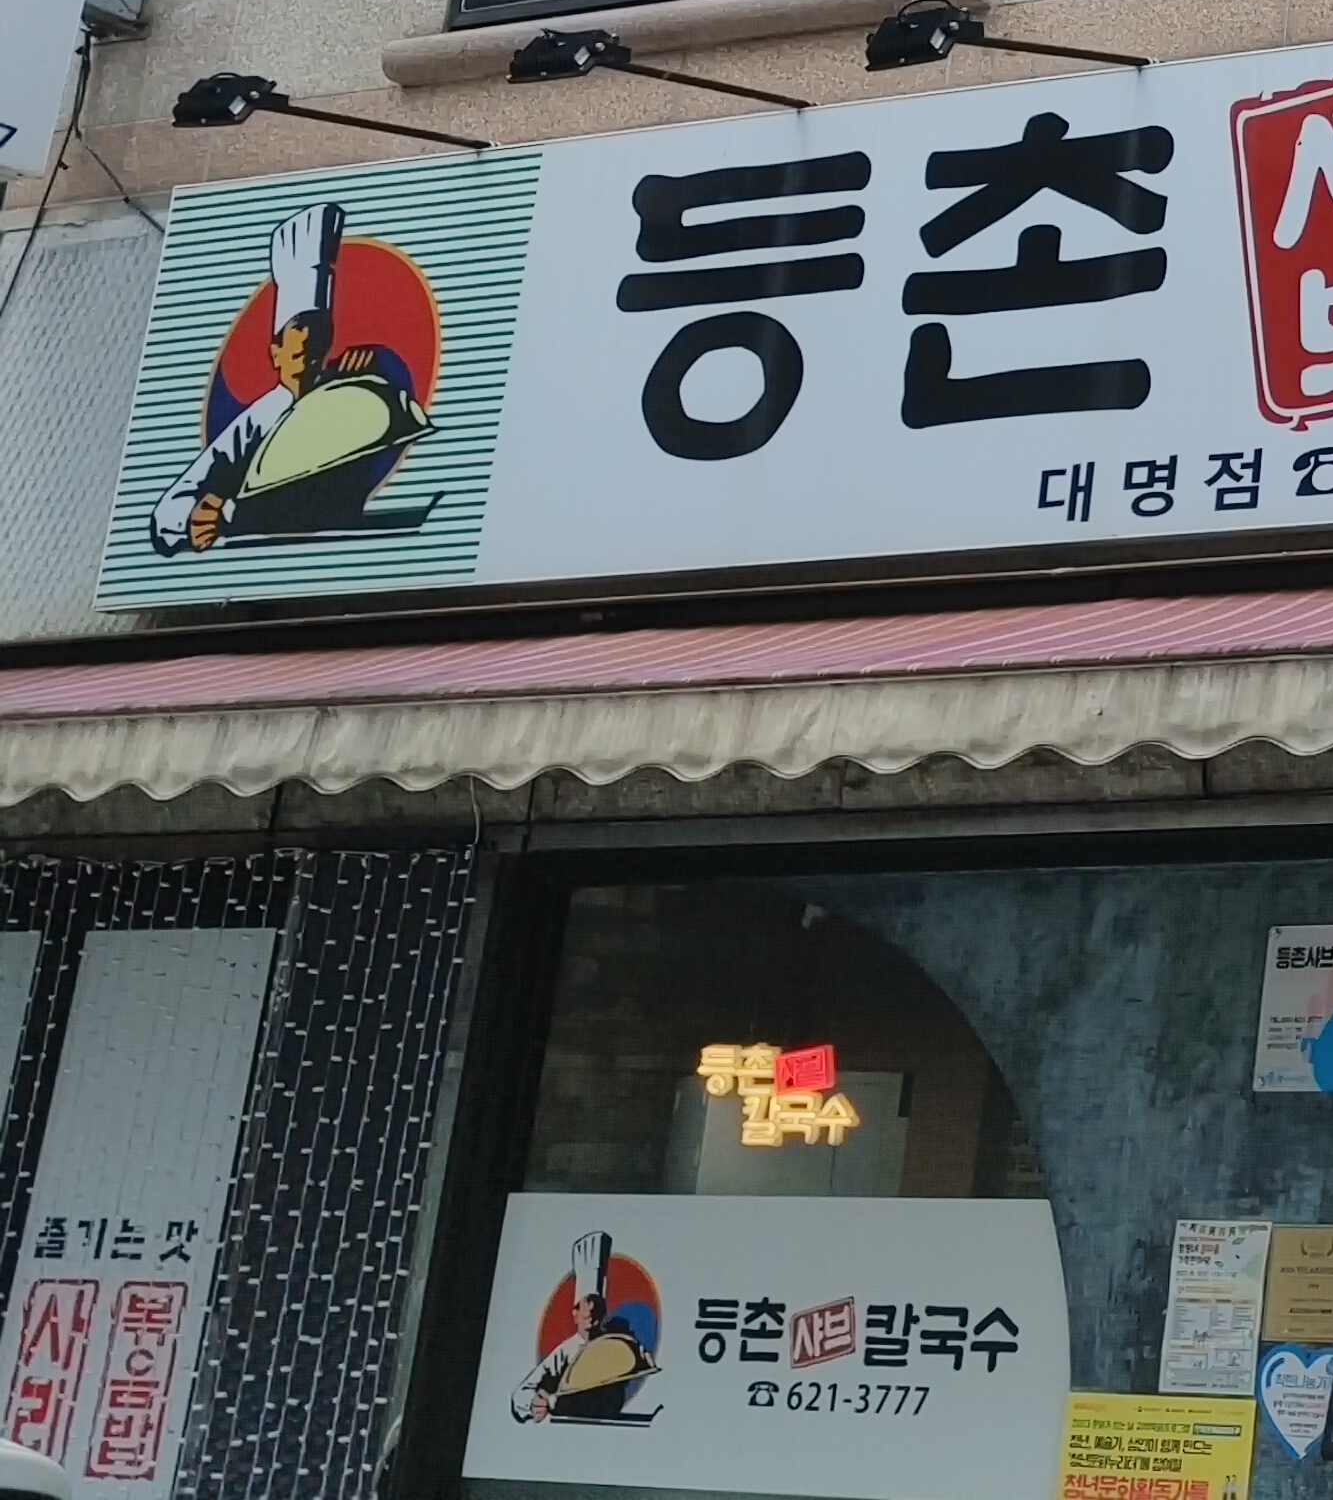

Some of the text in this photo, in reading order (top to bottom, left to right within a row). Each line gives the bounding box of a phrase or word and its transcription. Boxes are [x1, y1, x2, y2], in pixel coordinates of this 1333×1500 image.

[741, 1090, 860, 1147] 칼국수
[33, 1216, 199, 1264] 즐기는 맛
[787, 1381, 931, 1416] 621-3777
